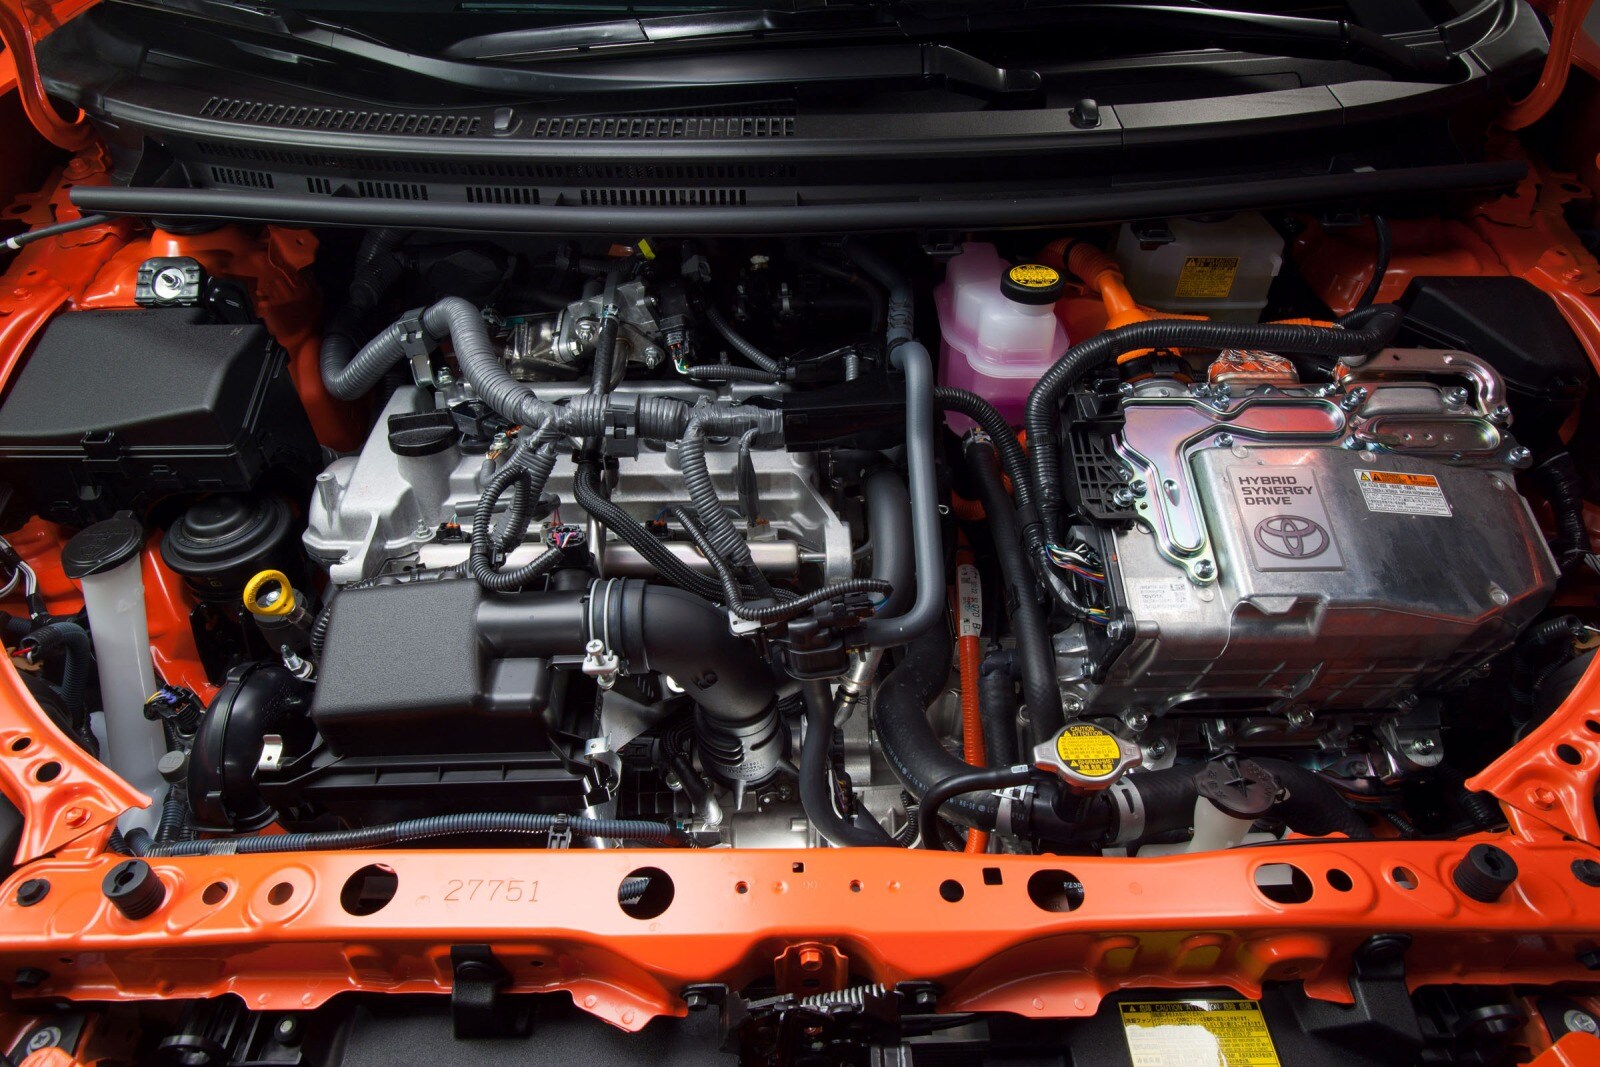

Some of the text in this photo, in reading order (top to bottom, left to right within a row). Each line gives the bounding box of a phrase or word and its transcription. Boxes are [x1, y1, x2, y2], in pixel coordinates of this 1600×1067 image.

[1238, 475, 1297, 486] HYBRID
[1241, 485, 1313, 496] SYNERGY
[1244, 496, 1292, 506] DRIVE
[443, 878, 539, 903] 27751
[1155, 1004, 1183, 1012] CAUTION
